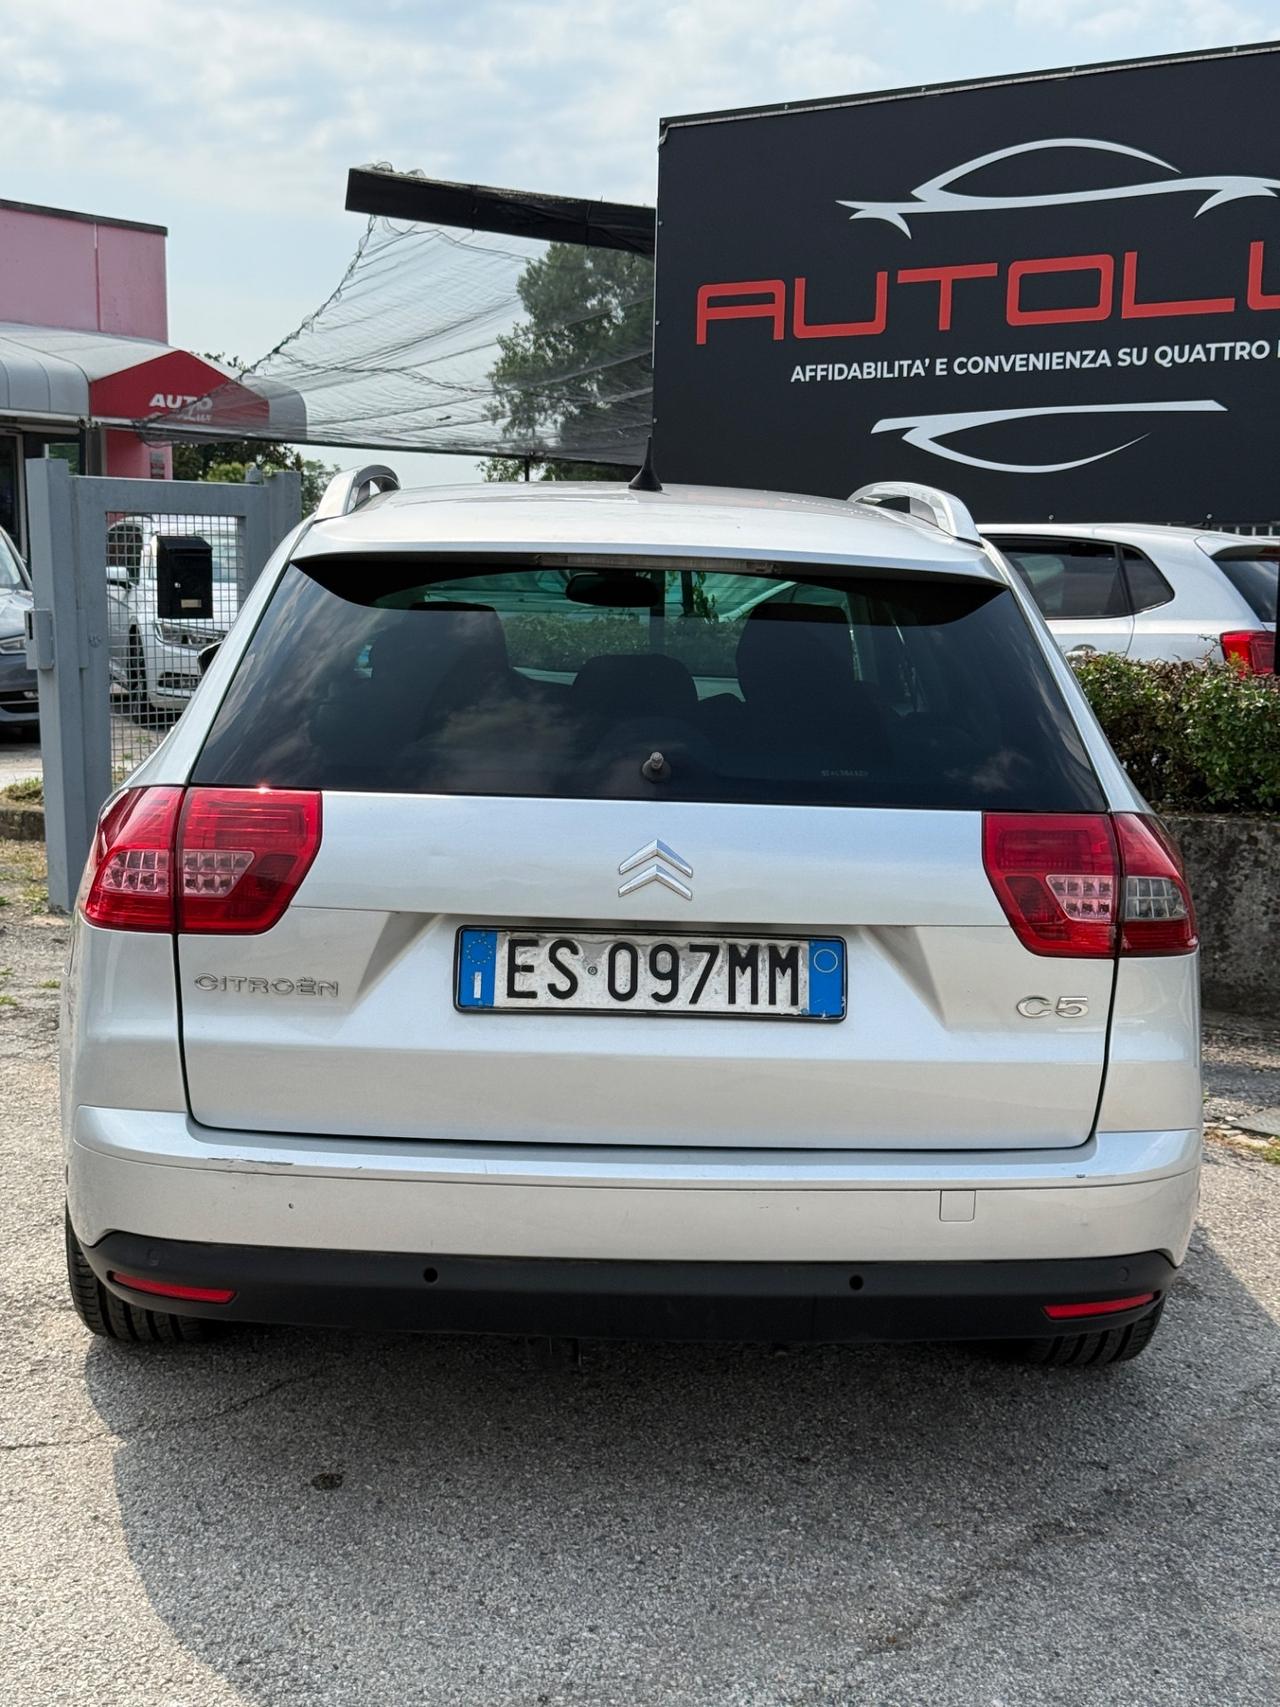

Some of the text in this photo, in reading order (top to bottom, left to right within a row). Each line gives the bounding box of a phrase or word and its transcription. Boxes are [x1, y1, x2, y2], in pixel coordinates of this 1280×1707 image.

[935, 358, 948, 376] E
[953, 350, 1112, 375] CONVENIENZA
[1117, 347, 1148, 367] SU
[1154, 340, 1270, 368] QUATTRO
[149, 393, 213, 411] AUTO
[506, 938, 579, 999] ES
[194, 972, 339, 998] CITROËN
[1016, 995, 1088, 1019] C5
